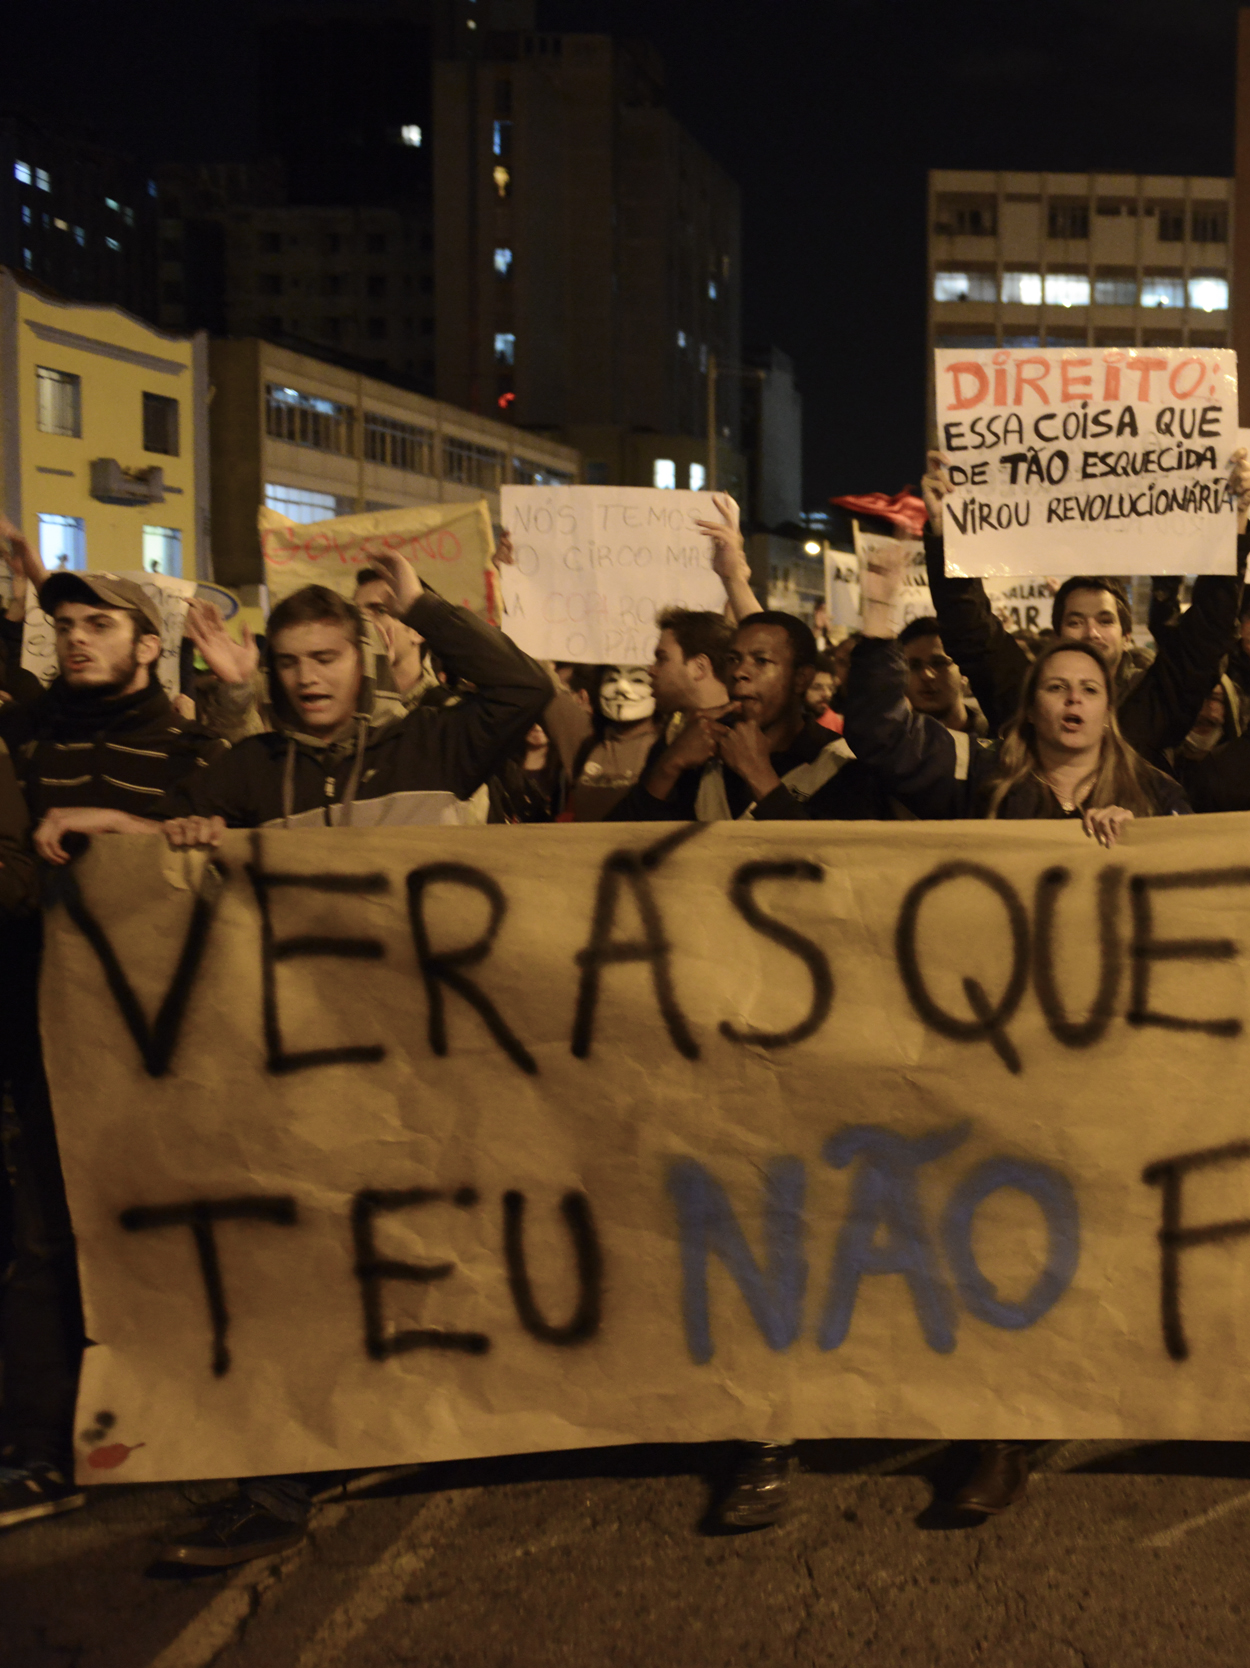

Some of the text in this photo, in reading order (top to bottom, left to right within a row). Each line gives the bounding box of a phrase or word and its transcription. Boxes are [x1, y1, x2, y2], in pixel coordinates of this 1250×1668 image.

[944, 401, 1222, 451] ESSA COISA QUE
[947, 441, 1217, 487] DE TÃO ESQUECIDA
[513, 498, 703, 535] NÓS TEMOS
[946, 497, 1030, 535] VIROU
[1046, 477, 1234, 523] REVOLUCIONÁRIA
[515, 544, 540, 576] O
[45, 815, 836, 1078] VERÁS
[118, 1186, 604, 1378] TEU
[662, 1119, 1083, 1366] NÃO
